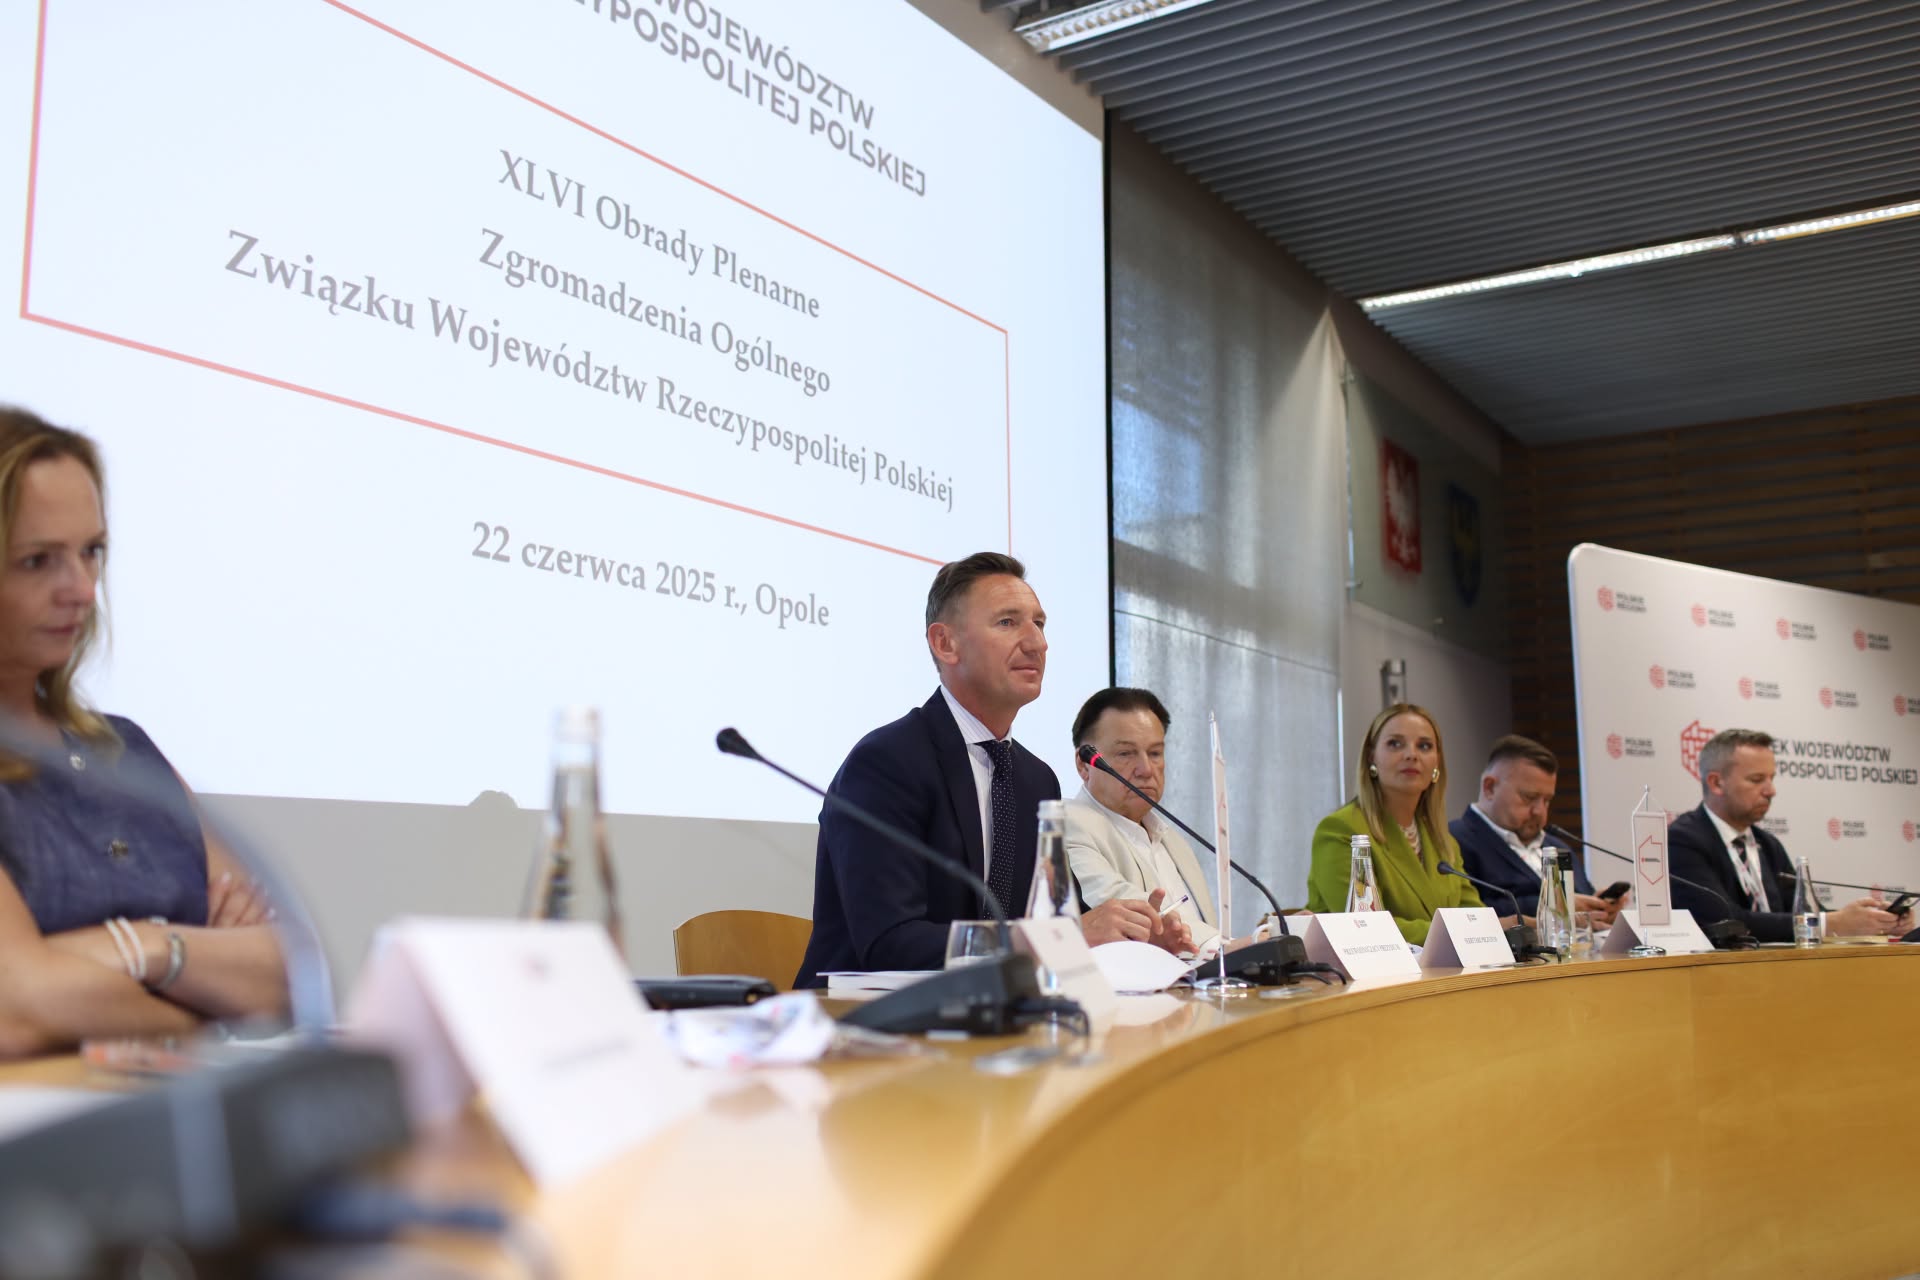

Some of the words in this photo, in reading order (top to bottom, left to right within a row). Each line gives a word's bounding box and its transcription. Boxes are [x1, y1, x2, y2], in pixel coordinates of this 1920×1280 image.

[576, 0, 799, 126] POSPOLITEJ
[810, 106, 926, 197] POLSKIEJ
[479, 227, 702, 345] Zgromadzenia
[711, 321, 831, 398] Ogólnego
[499, 149, 586, 219] XLVI
[595, 196, 705, 277] Obrady
[712, 244, 820, 319] Plenarne
[224, 229, 415, 330] Związku
[428, 297, 648, 403] Województw
[656, 375, 866, 485] Rzeczypospolitej
[874, 451, 953, 513] Polskiej
[471, 521, 511, 563] 22
[521, 543, 646, 590] czerwca
[655, 561, 716, 603] 2025
[724, 585, 747, 616] r.,
[755, 583, 830, 630] Opole
[1771, 737, 1788, 756] EK
[1793, 739, 1891, 763] WOJEWÓDZTW
[1862, 766, 1918, 785] POLSKIEJ
